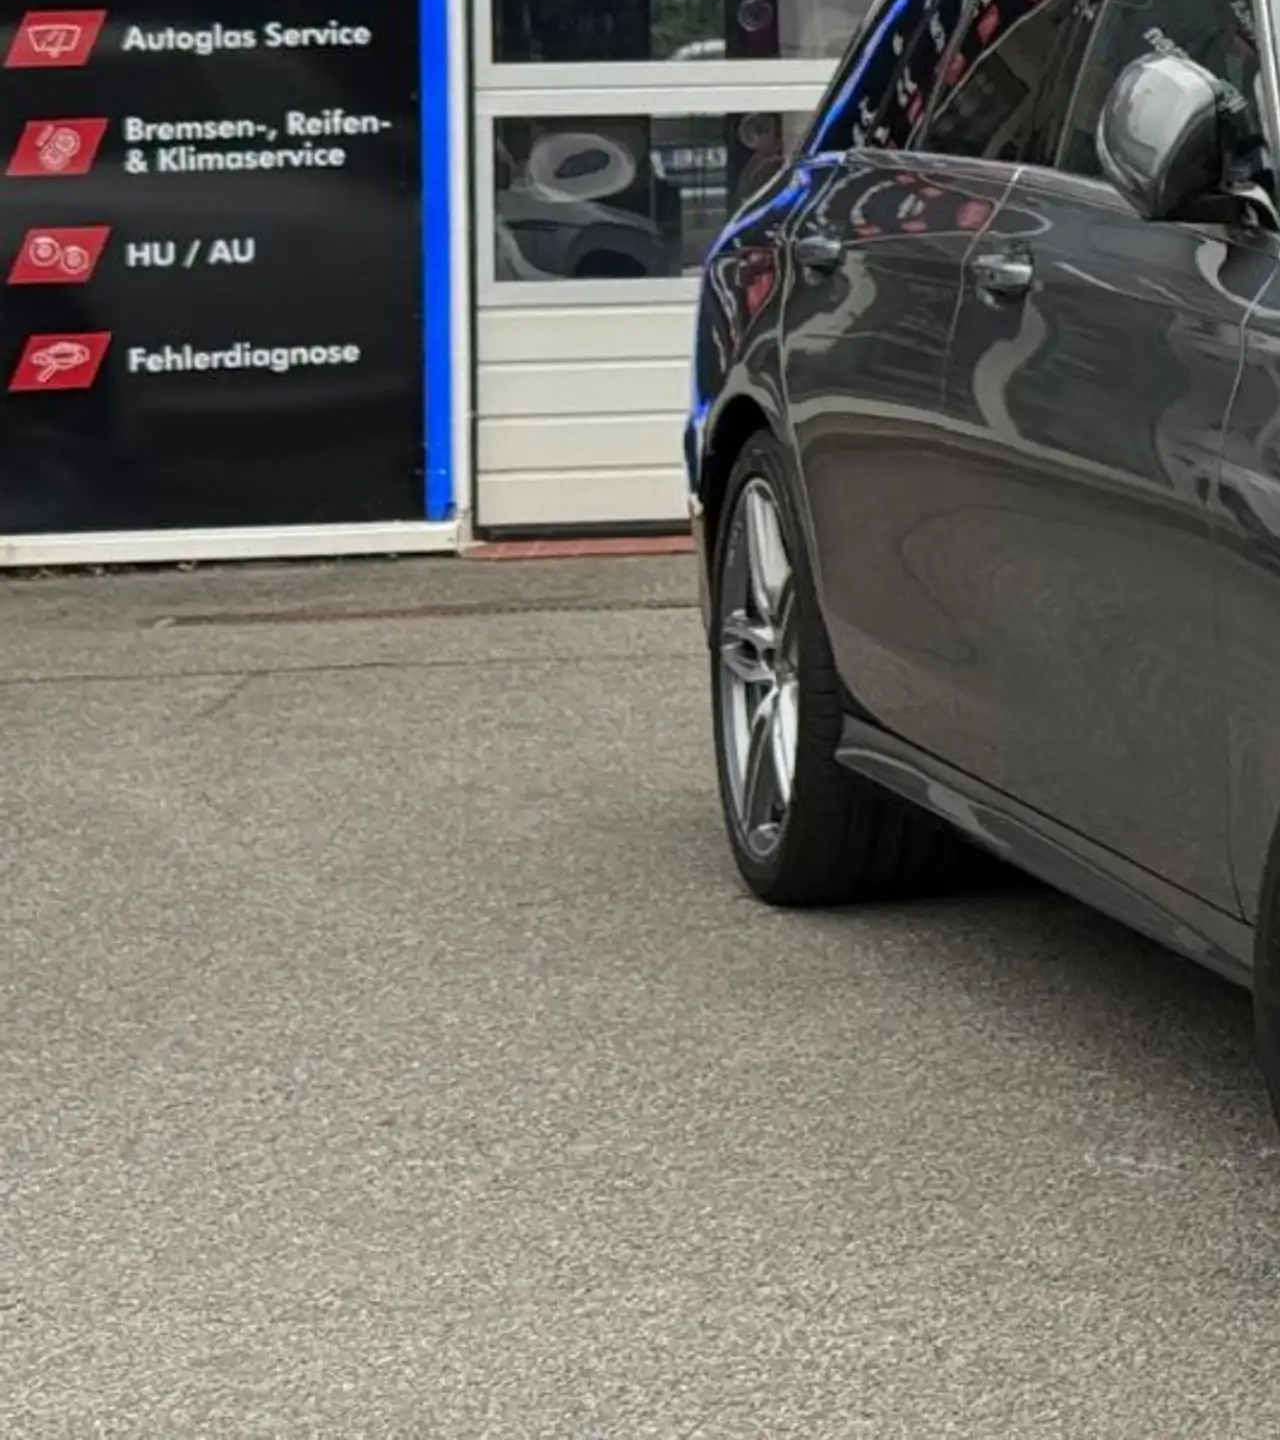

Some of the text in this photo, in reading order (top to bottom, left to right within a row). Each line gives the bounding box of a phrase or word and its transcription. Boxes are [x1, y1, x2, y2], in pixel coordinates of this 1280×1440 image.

[122, 20, 371, 55] Autoglas Service
[287, 109, 391, 135] Reifen-
[125, 142, 345, 173] & Klimaservice
[128, 238, 254, 267] HU / AU
[129, 343, 360, 375] Fehlerdiagnose
